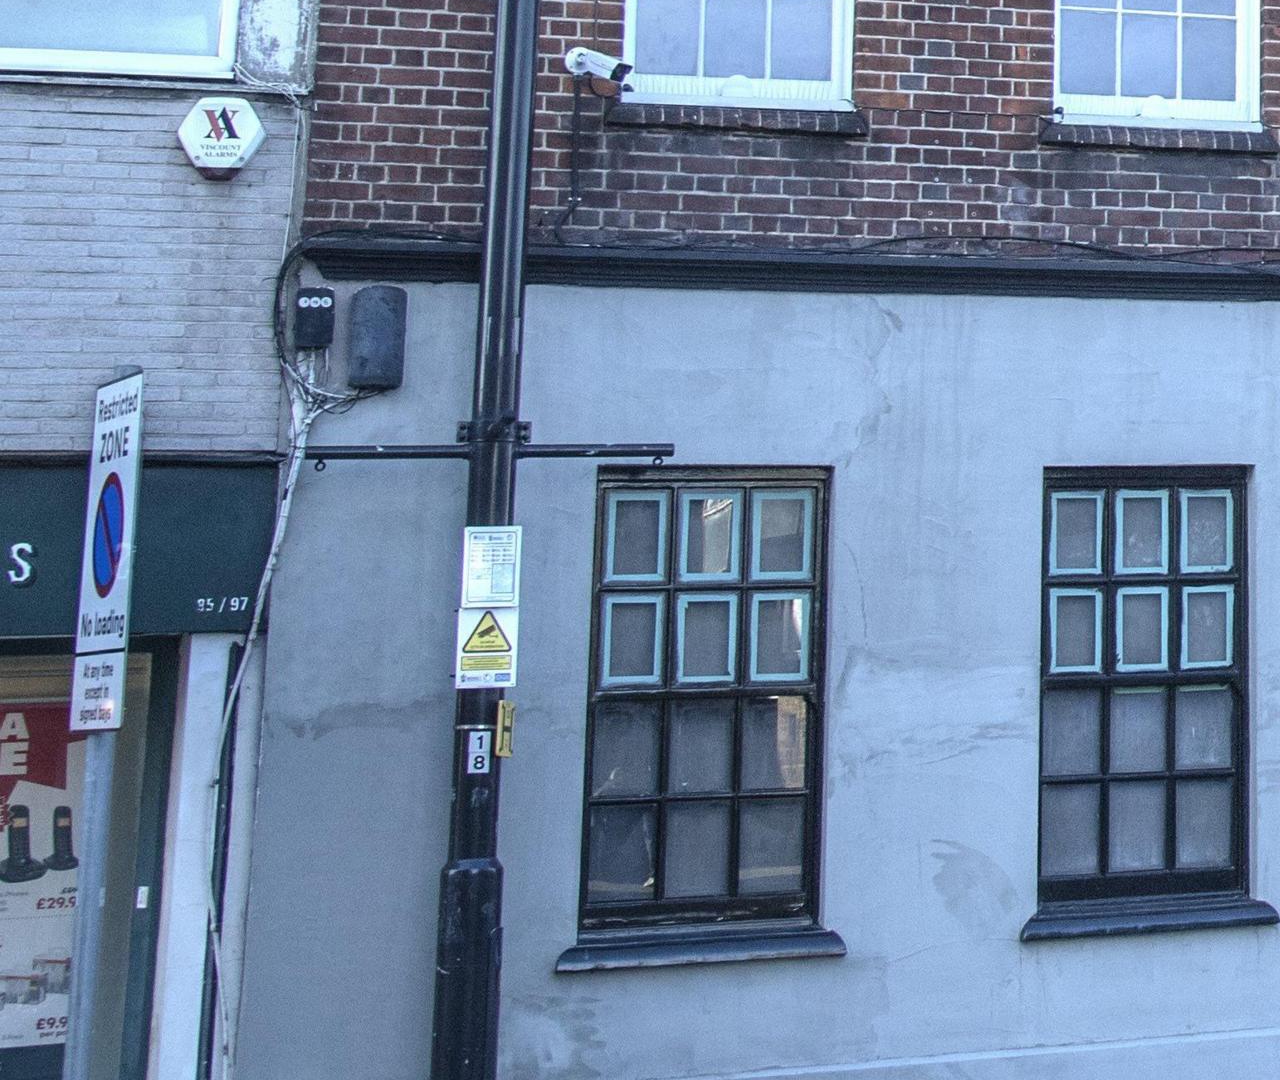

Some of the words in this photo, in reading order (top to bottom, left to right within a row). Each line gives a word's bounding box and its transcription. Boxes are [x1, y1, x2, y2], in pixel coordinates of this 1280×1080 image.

[98, 386, 139, 424] Restricted
[99, 425, 130, 464] ZONE
[81, 612, 93, 638] No
[94, 607, 125, 639] loading
[477, 734, 484, 750] 1
[473, 755, 485, 770] 8
[36, 895, 76, 910] £29.9
[36, 1016, 68, 1030] £9.9
